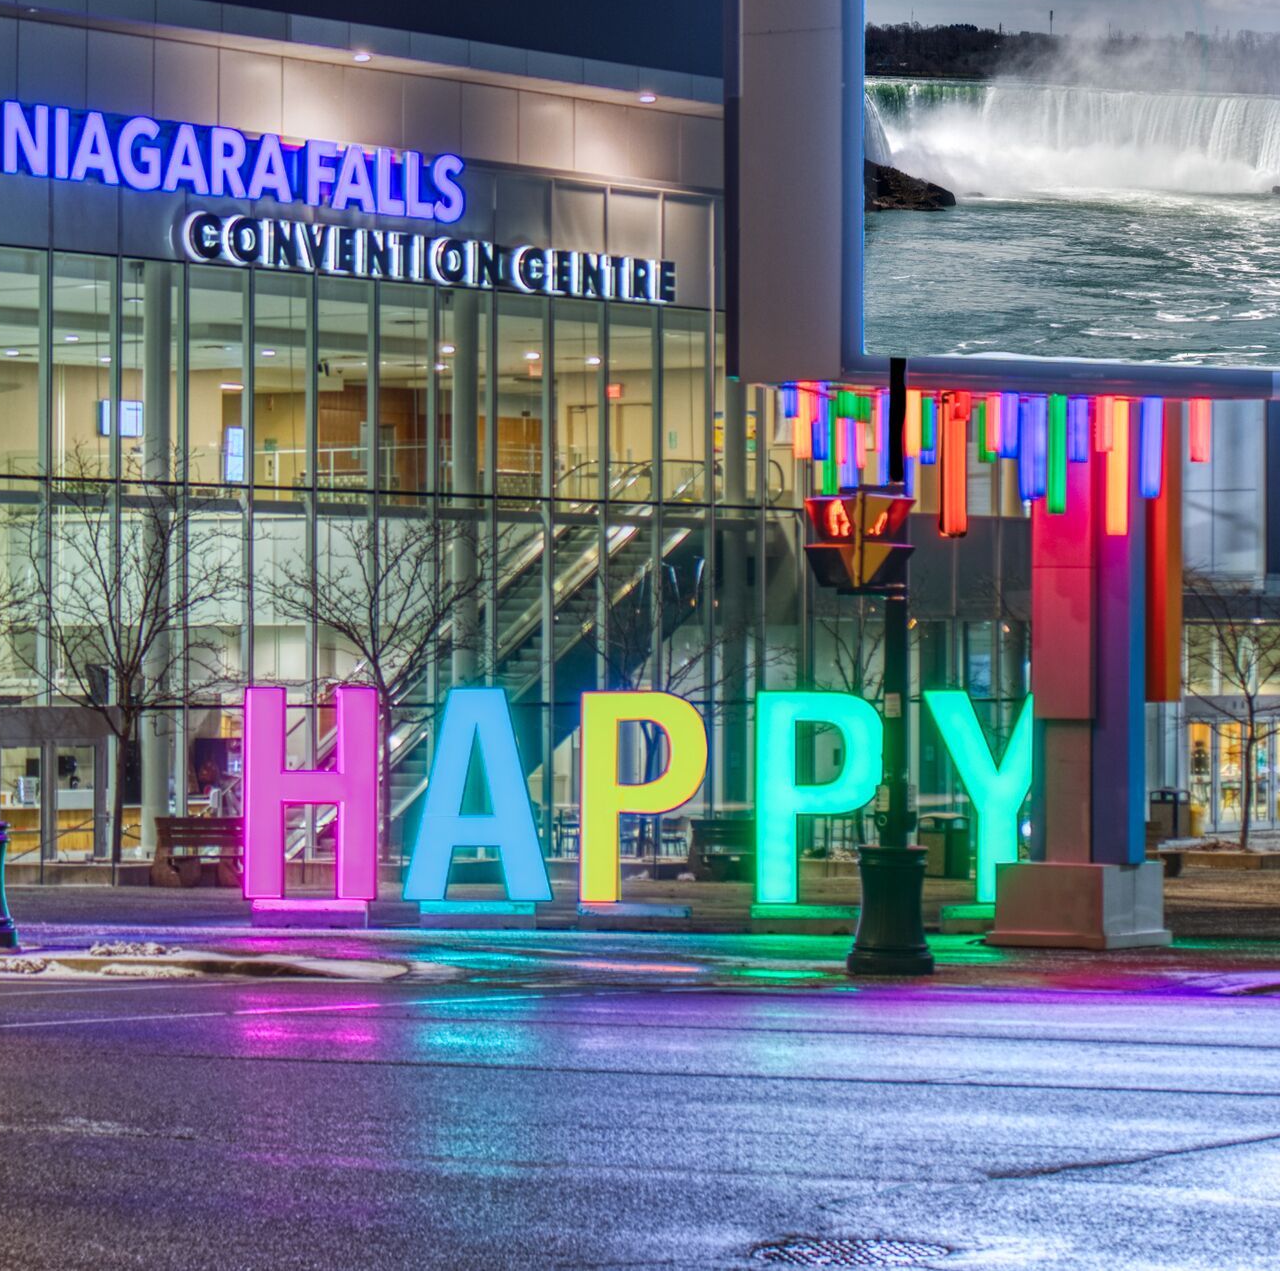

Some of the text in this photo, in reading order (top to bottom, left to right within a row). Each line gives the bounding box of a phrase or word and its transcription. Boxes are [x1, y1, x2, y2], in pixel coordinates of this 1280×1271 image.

[0, 99, 466, 224] NIAGARA FALLS
[184, 210, 677, 302] CONVENTION CENTRE
[243, 686, 1034, 904] HAPPY
